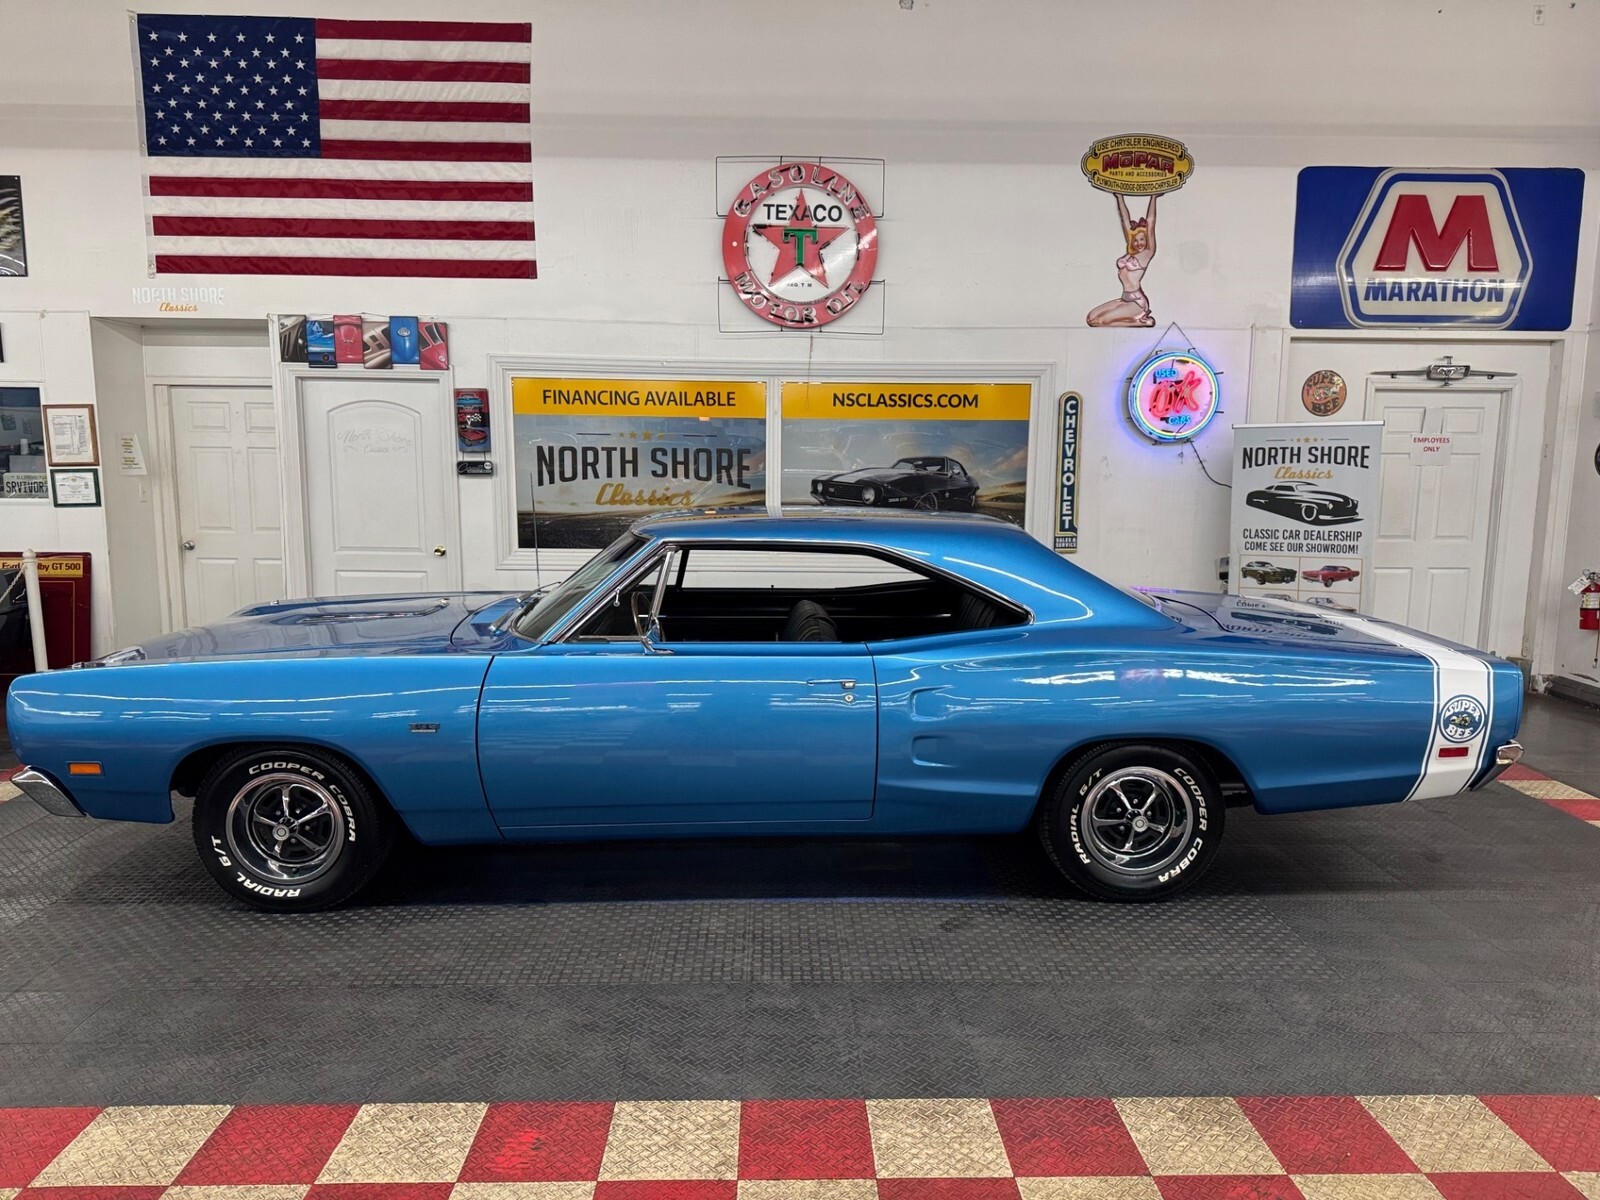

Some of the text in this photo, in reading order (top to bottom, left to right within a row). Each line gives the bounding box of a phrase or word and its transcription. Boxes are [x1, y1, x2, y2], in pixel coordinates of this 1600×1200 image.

[1097, 138, 1180, 152] USE CHRYSLER ENGINEERED
[733, 164, 871, 223] GASOLINE
[763, 203, 843, 223] TEXACO
[1372, 194, 1500, 272] M
[132, 287, 225, 305] NORTH SHORE
[734, 271, 817, 325] MOTOR
[1363, 277, 1504, 303] MARATHON
[159, 302, 198, 312] Classics
[1155, 369, 1178, 378] USED
[542, 389, 736, 407] FINANCING AVAILABLE
[832, 392, 979, 408] NSCLASSICS.COM
[1168, 415, 1191, 425] CARS
[1413, 436, 1450, 444] EMPLOYEES
[536, 445, 752, 490] NORTH SHORE
[1062, 400, 1077, 529] CHEVROLET
[1242, 445, 1371, 470] NORTH SHORE
[1273, 466, 1334, 479] Classics
[595, 482, 697, 507] Classics
[1243, 528, 1362, 542] CLASSIC CAR DEALERSHIP
[1244, 541, 1359, 554] COME SEE OUR SHOWROOM!
[52, 562, 64, 571] GT
[65, 562, 81, 571] 500
[1444, 700, 1481, 722] SUPER
[1445, 724, 1474, 738] BEE
[248, 761, 357, 842] COOPER COBRA
[1070, 768, 1103, 865] RADIAL G/T
[1157, 767, 1208, 883] COOPER COBRA
[211, 835, 302, 898] RADIAL G/T
